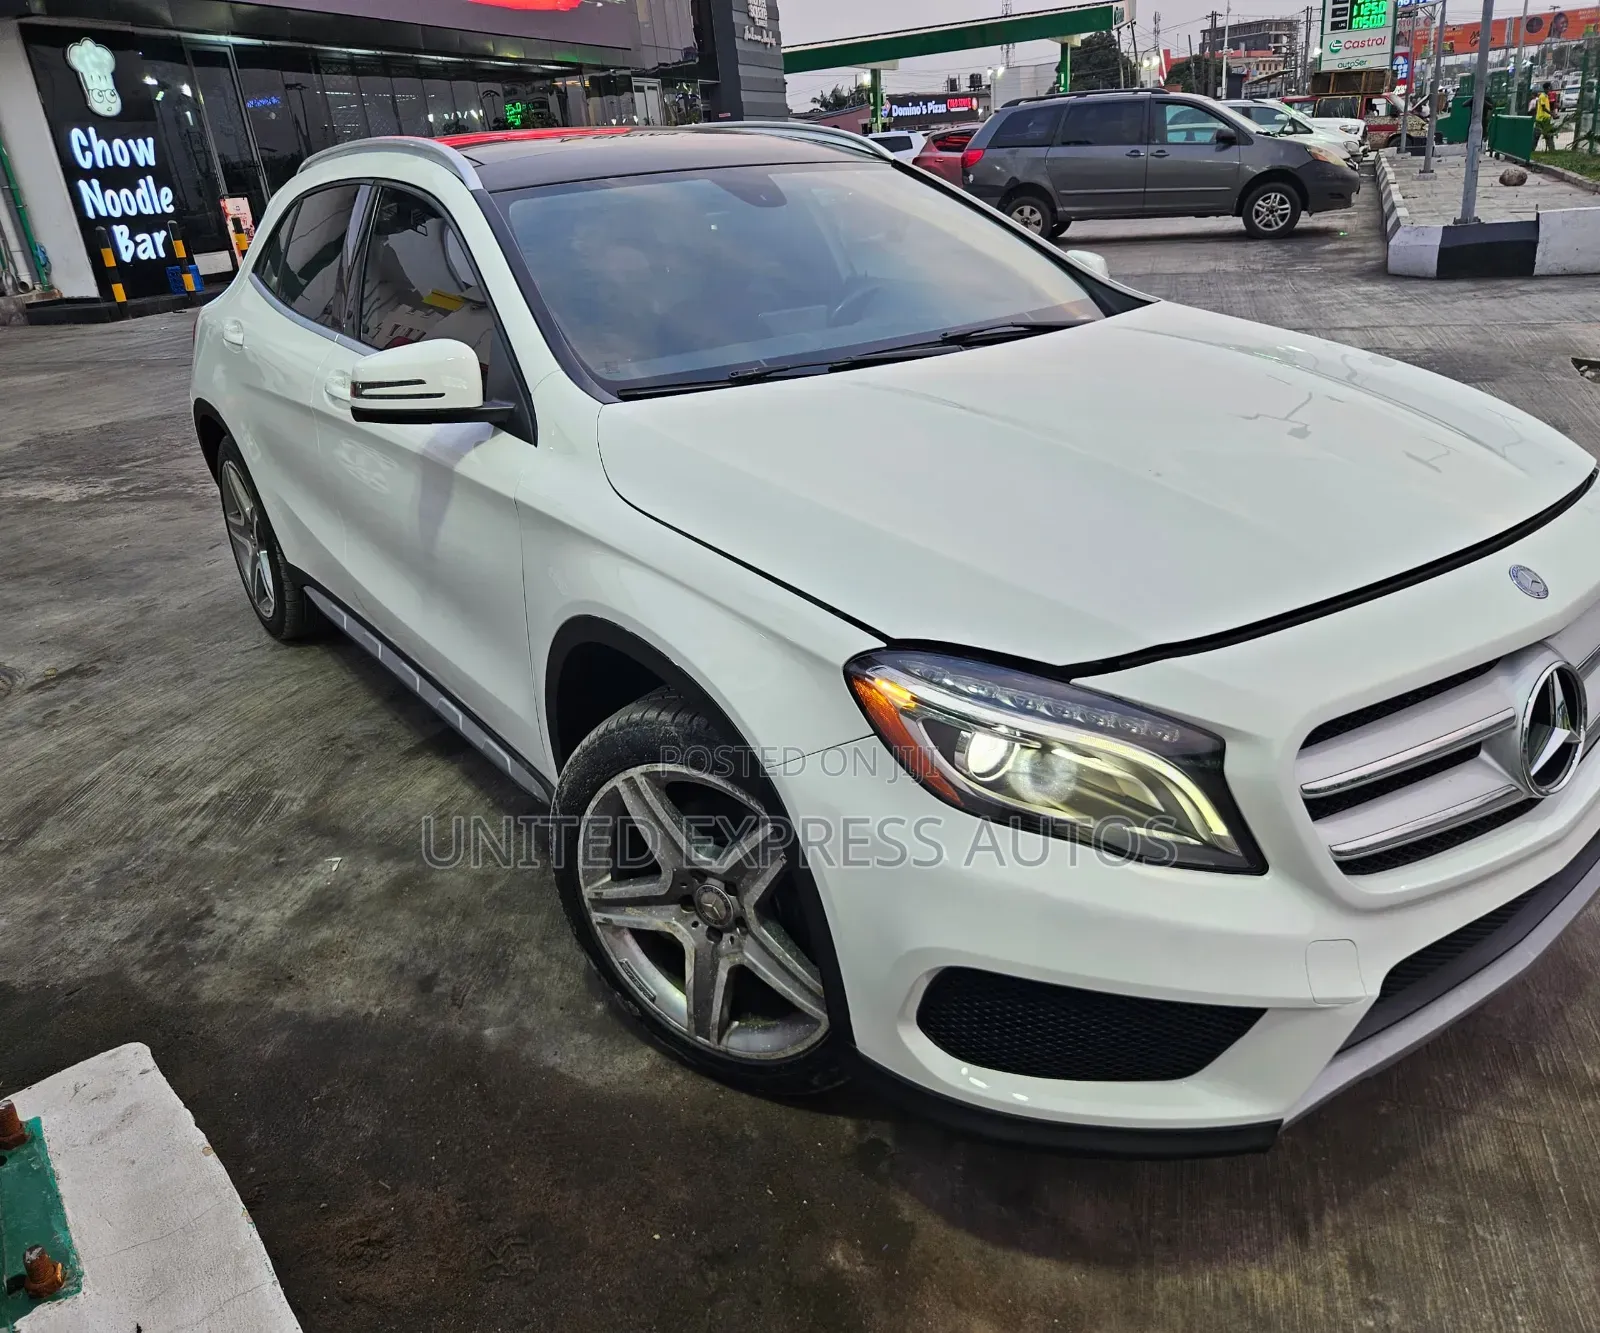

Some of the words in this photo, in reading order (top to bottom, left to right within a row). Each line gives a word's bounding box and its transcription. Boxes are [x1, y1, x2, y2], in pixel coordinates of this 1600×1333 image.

[1398, 18, 1420, 27] STOE
[1343, 36, 1386, 50] Castrol
[892, 101, 926, 116] Domino's
[927, 100, 946, 114] Pizza
[70, 126, 156, 169] Chow
[77, 175, 175, 220] Noodle
[111, 224, 167, 263] Bar
